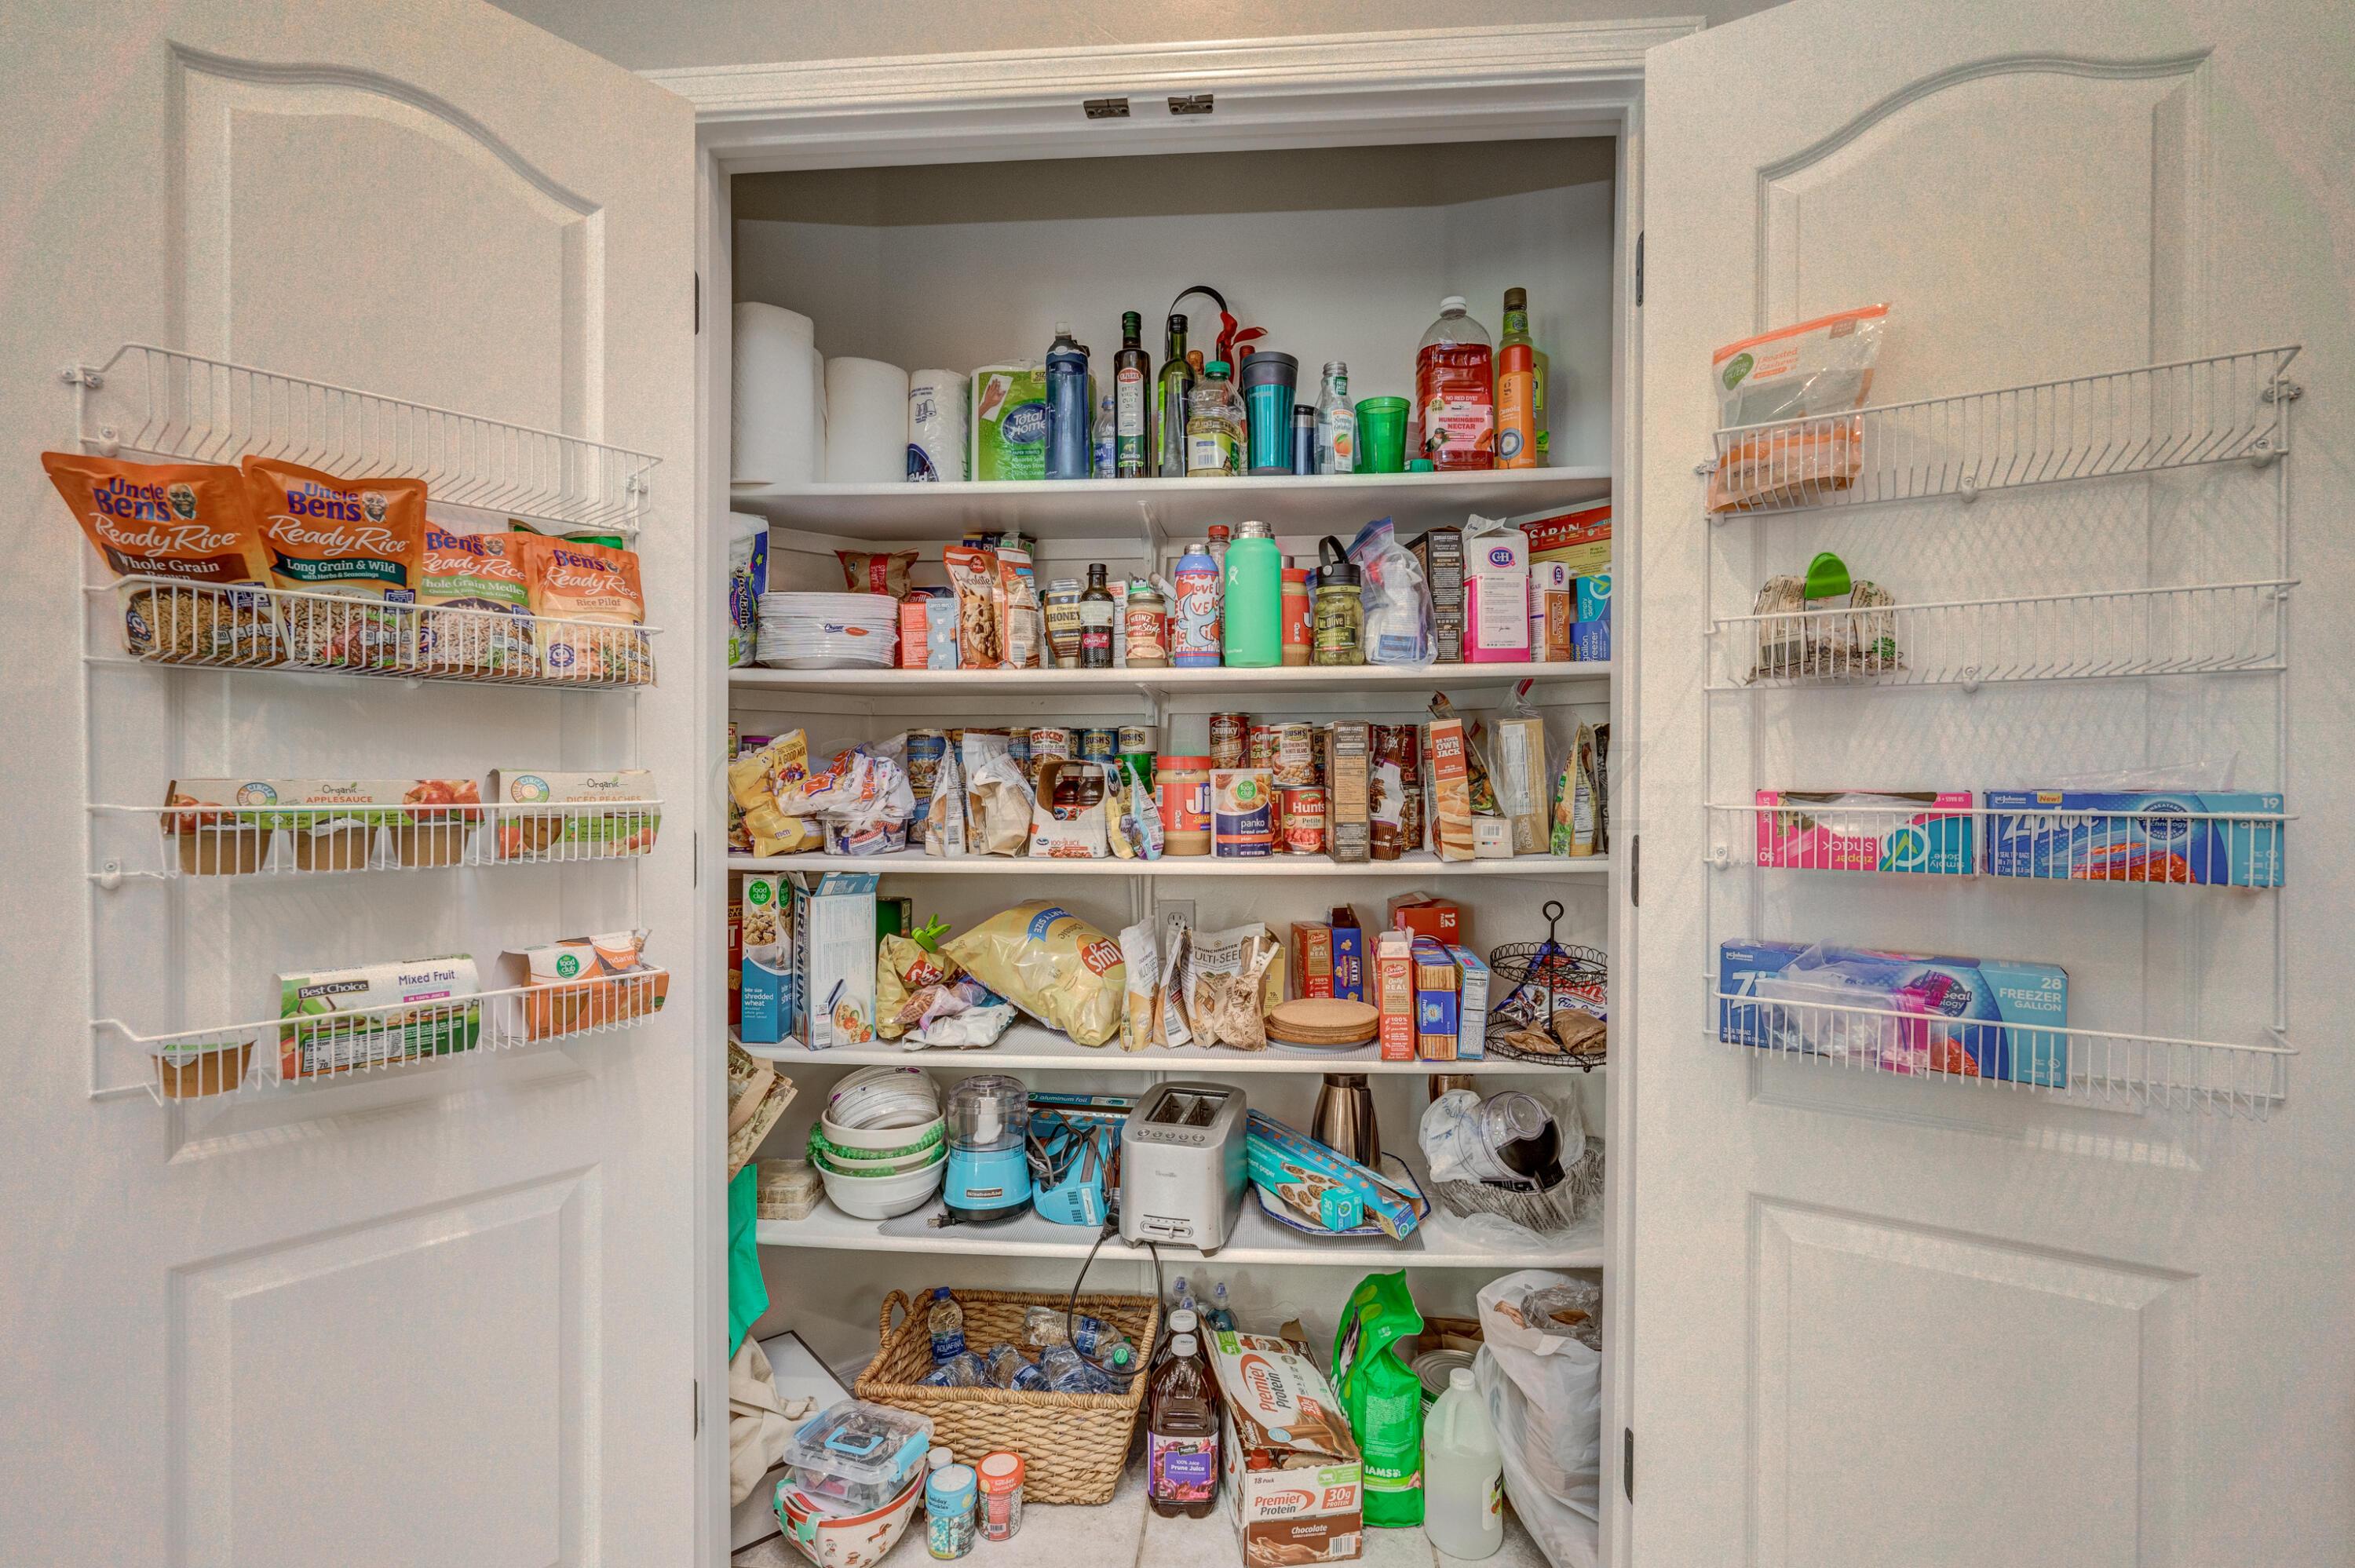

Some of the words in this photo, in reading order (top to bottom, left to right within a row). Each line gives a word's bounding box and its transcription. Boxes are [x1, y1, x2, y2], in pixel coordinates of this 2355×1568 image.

[1013, 410, 1043, 426] Total
[1011, 420, 1046, 436] Home
[109, 477, 164, 500] Uncle
[304, 482, 359, 502] Uncle
[93, 487, 171, 523] Ben's
[287, 490, 362, 523] Ben's
[89, 512, 176, 556] Ready
[169, 525, 236, 552] Rice
[268, 515, 356, 556] Ready
[355, 527, 407, 556] Rice
[118, 551, 166, 571] Whole
[169, 560, 221, 574] Grain
[1492, 552, 1510, 562] C&H
[287, 558, 316, 574] Long
[318, 560, 353, 573] Grain
[356, 560, 366, 571] &
[367, 560, 396, 574] Wild
[422, 552, 481, 576] Ready
[481, 559, 526, 580] Rice
[147, 571, 192, 581] Brown
[545, 566, 605, 596] Ready
[603, 575, 638, 599] Rice
[453, 578, 485, 589] Grain
[487, 582, 526, 598] Medley
[1191, 583, 1214, 594] LOVE
[597, 598, 622, 607] Pilaf
[910, 593, 931, 603] arilla
[1049, 611, 1080, 622] HONEY
[1130, 614, 1151, 623] HEINZ
[1327, 616, 1343, 628] Olive
[1031, 731, 1064, 742] STOKES
[1120, 732, 1145, 742] BUSH'S
[1211, 727, 1238, 735] CHUNKY
[1285, 729, 1307, 738] BUSH'S
[1085, 735, 1111, 746] BUSH'S
[1437, 742, 1459, 751] OWN
[778, 756, 783, 766] A
[783, 749, 797, 764] GOOD
[1437, 749, 1462, 759] JACK
[323, 783, 358, 797] Organic
[586, 778, 620, 791] Organic
[305, 796, 374, 804] APPLESAUCE
[1186, 787, 1210, 815] Ji
[2261, 797, 2280, 809] 19
[1240, 818, 1265, 829] panko
[1822, 841, 1874, 852] snack
[1835, 855, 1874, 865] zipper
[1034, 917, 1049, 934] SIZE
[1444, 912, 1455, 928] 12
[796, 895, 806, 1012] PREMIUM
[1194, 943, 1239, 954] CRUNCHMASTER
[560, 958, 575, 968] food
[608, 954, 635, 965] ndarin
[1087, 939, 1125, 974] Lay's
[1194, 948, 1242, 965] ULTI-SEE
[561, 965, 576, 974] club
[398, 972, 430, 986] Mixed
[433, 970, 455, 982] Fruit
[2041, 977, 2062, 990] 28
[300, 986, 327, 998] Best
[327, 981, 367, 995] Choice
[1943, 988, 1971, 1001] Seal
[1999, 987, 2062, 1003] FREEZER
[1557, 997, 1576, 1009] Fun
[2014, 1001, 2061, 1012] GALLON
[1039, 1094, 1075, 1103] aluminum
[1259, 1165, 1276, 1179] paper
[1324, 1198, 1333, 1209] 30
[1249, 1366, 1279, 1413] Premier
[1267, 1372, 1292, 1410] Protein
[1364, 1464, 1393, 1478] IAMS
[1254, 1493, 1302, 1508] Premier
[1327, 1487, 1351, 1503] 30g
[1260, 1504, 1297, 1516] Protein
[1326, 1500, 1350, 1508] PROTEIN
[1291, 1524, 1328, 1535] Chocolate
